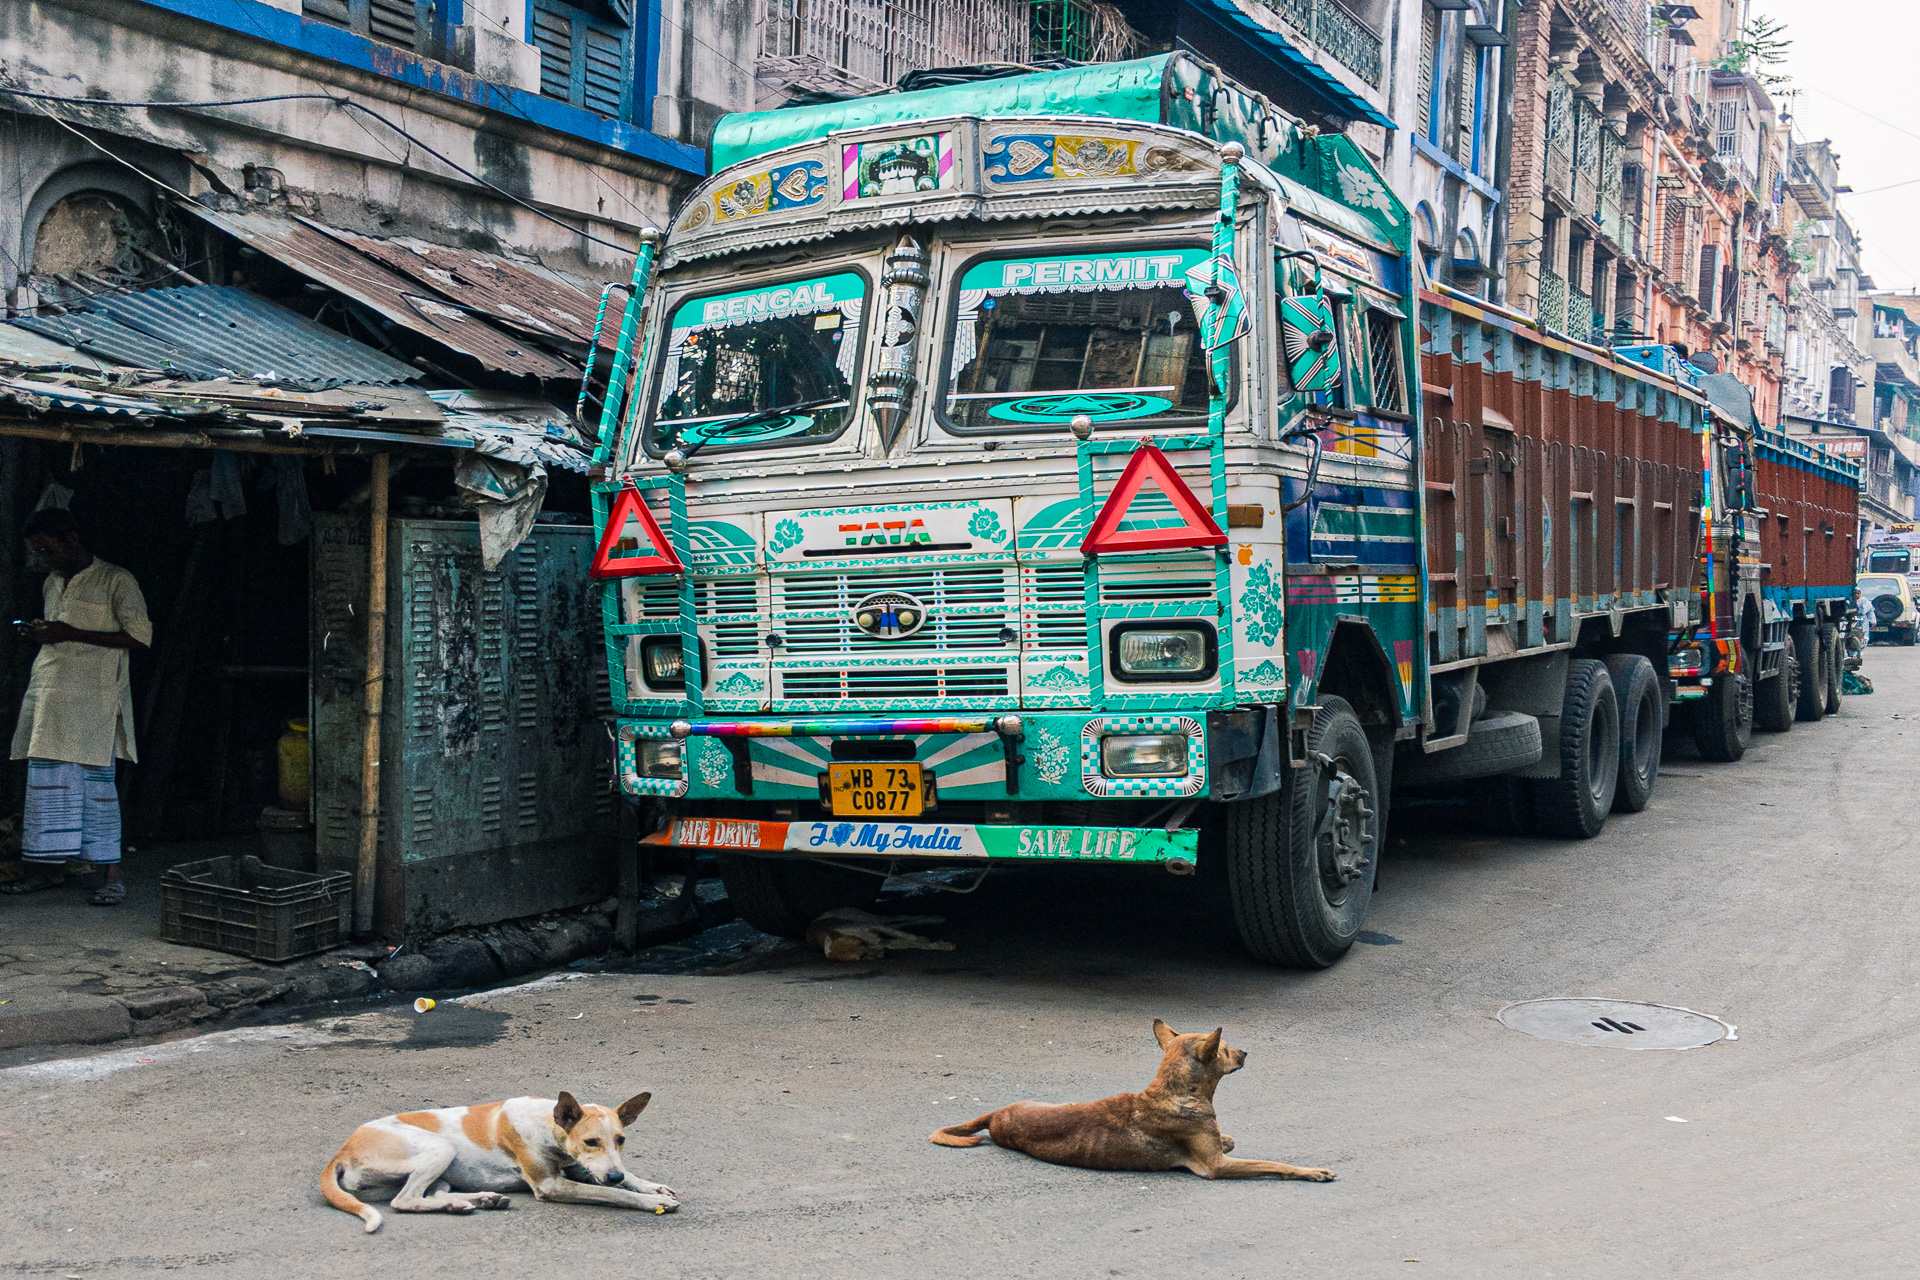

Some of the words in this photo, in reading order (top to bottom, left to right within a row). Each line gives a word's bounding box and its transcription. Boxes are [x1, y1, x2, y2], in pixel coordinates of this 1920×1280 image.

[1002, 255, 1183, 286] PERMIT
[703, 282, 834, 322] BENGAL
[838, 518, 931, 545] TATA
[850, 768, 873, 788] WB
[886, 768, 909, 789] 73
[852, 790, 910, 811] C0877
[713, 821, 762, 848] DRIVE
[850, 824, 891, 853] My
[892, 825, 963, 851] India
[1017, 828, 1073, 857] SAVE
[1080, 829, 1137, 859] LIFE
